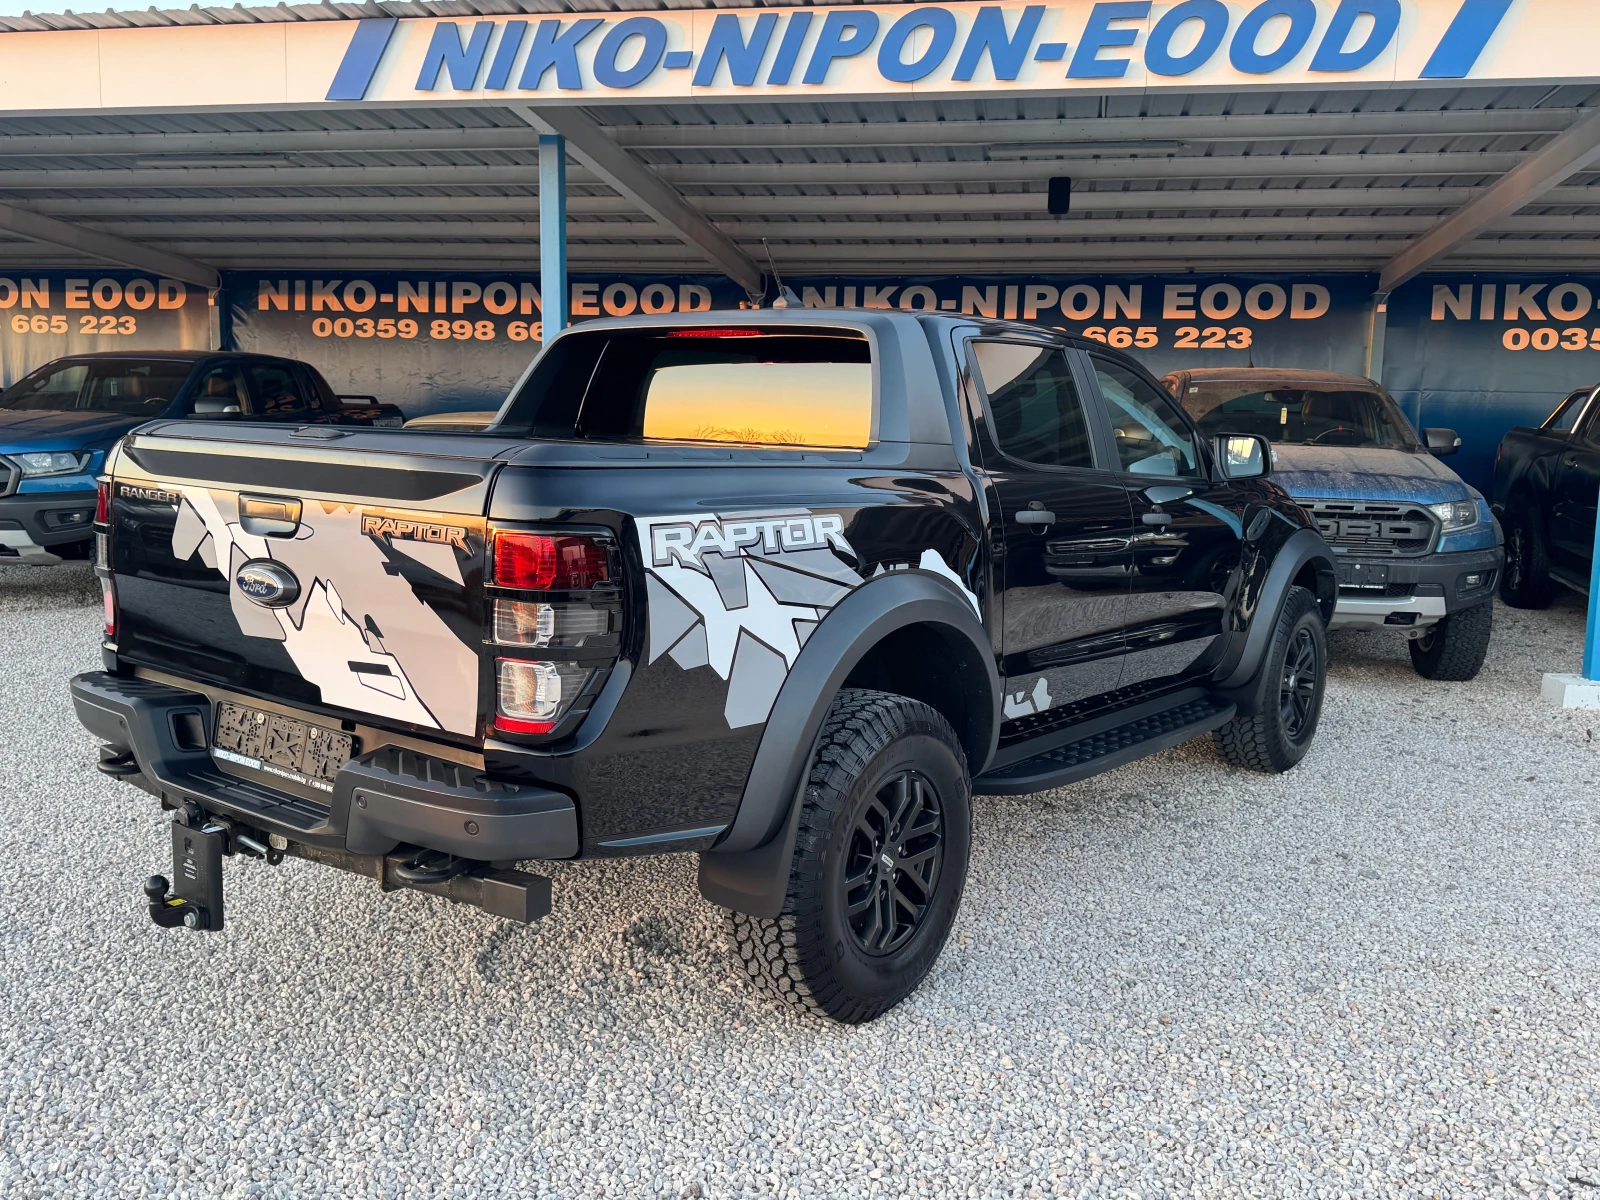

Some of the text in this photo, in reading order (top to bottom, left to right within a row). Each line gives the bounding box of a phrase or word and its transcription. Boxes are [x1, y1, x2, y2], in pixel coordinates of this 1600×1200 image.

[414, 0, 1401, 91] NIKO-NIPON-EOOD
[65, 278, 187, 310] EOOD
[258, 280, 712, 316] NIKO-NIPON EOOD
[802, 283, 1331, 320] NIKO-NIPON EOOD
[1430, 283, 1600, 321] NIKO
[11, 315, 137, 335] 665 223
[312, 317, 419, 339] 00359
[429, 320, 495, 341] 898
[1173, 327, 1253, 349] 223
[119, 485, 178, 503] RANGER
[361, 514, 475, 557] RAPTOR
[651, 513, 858, 573] RAPTOR
[242, 572, 269, 597] Ford
